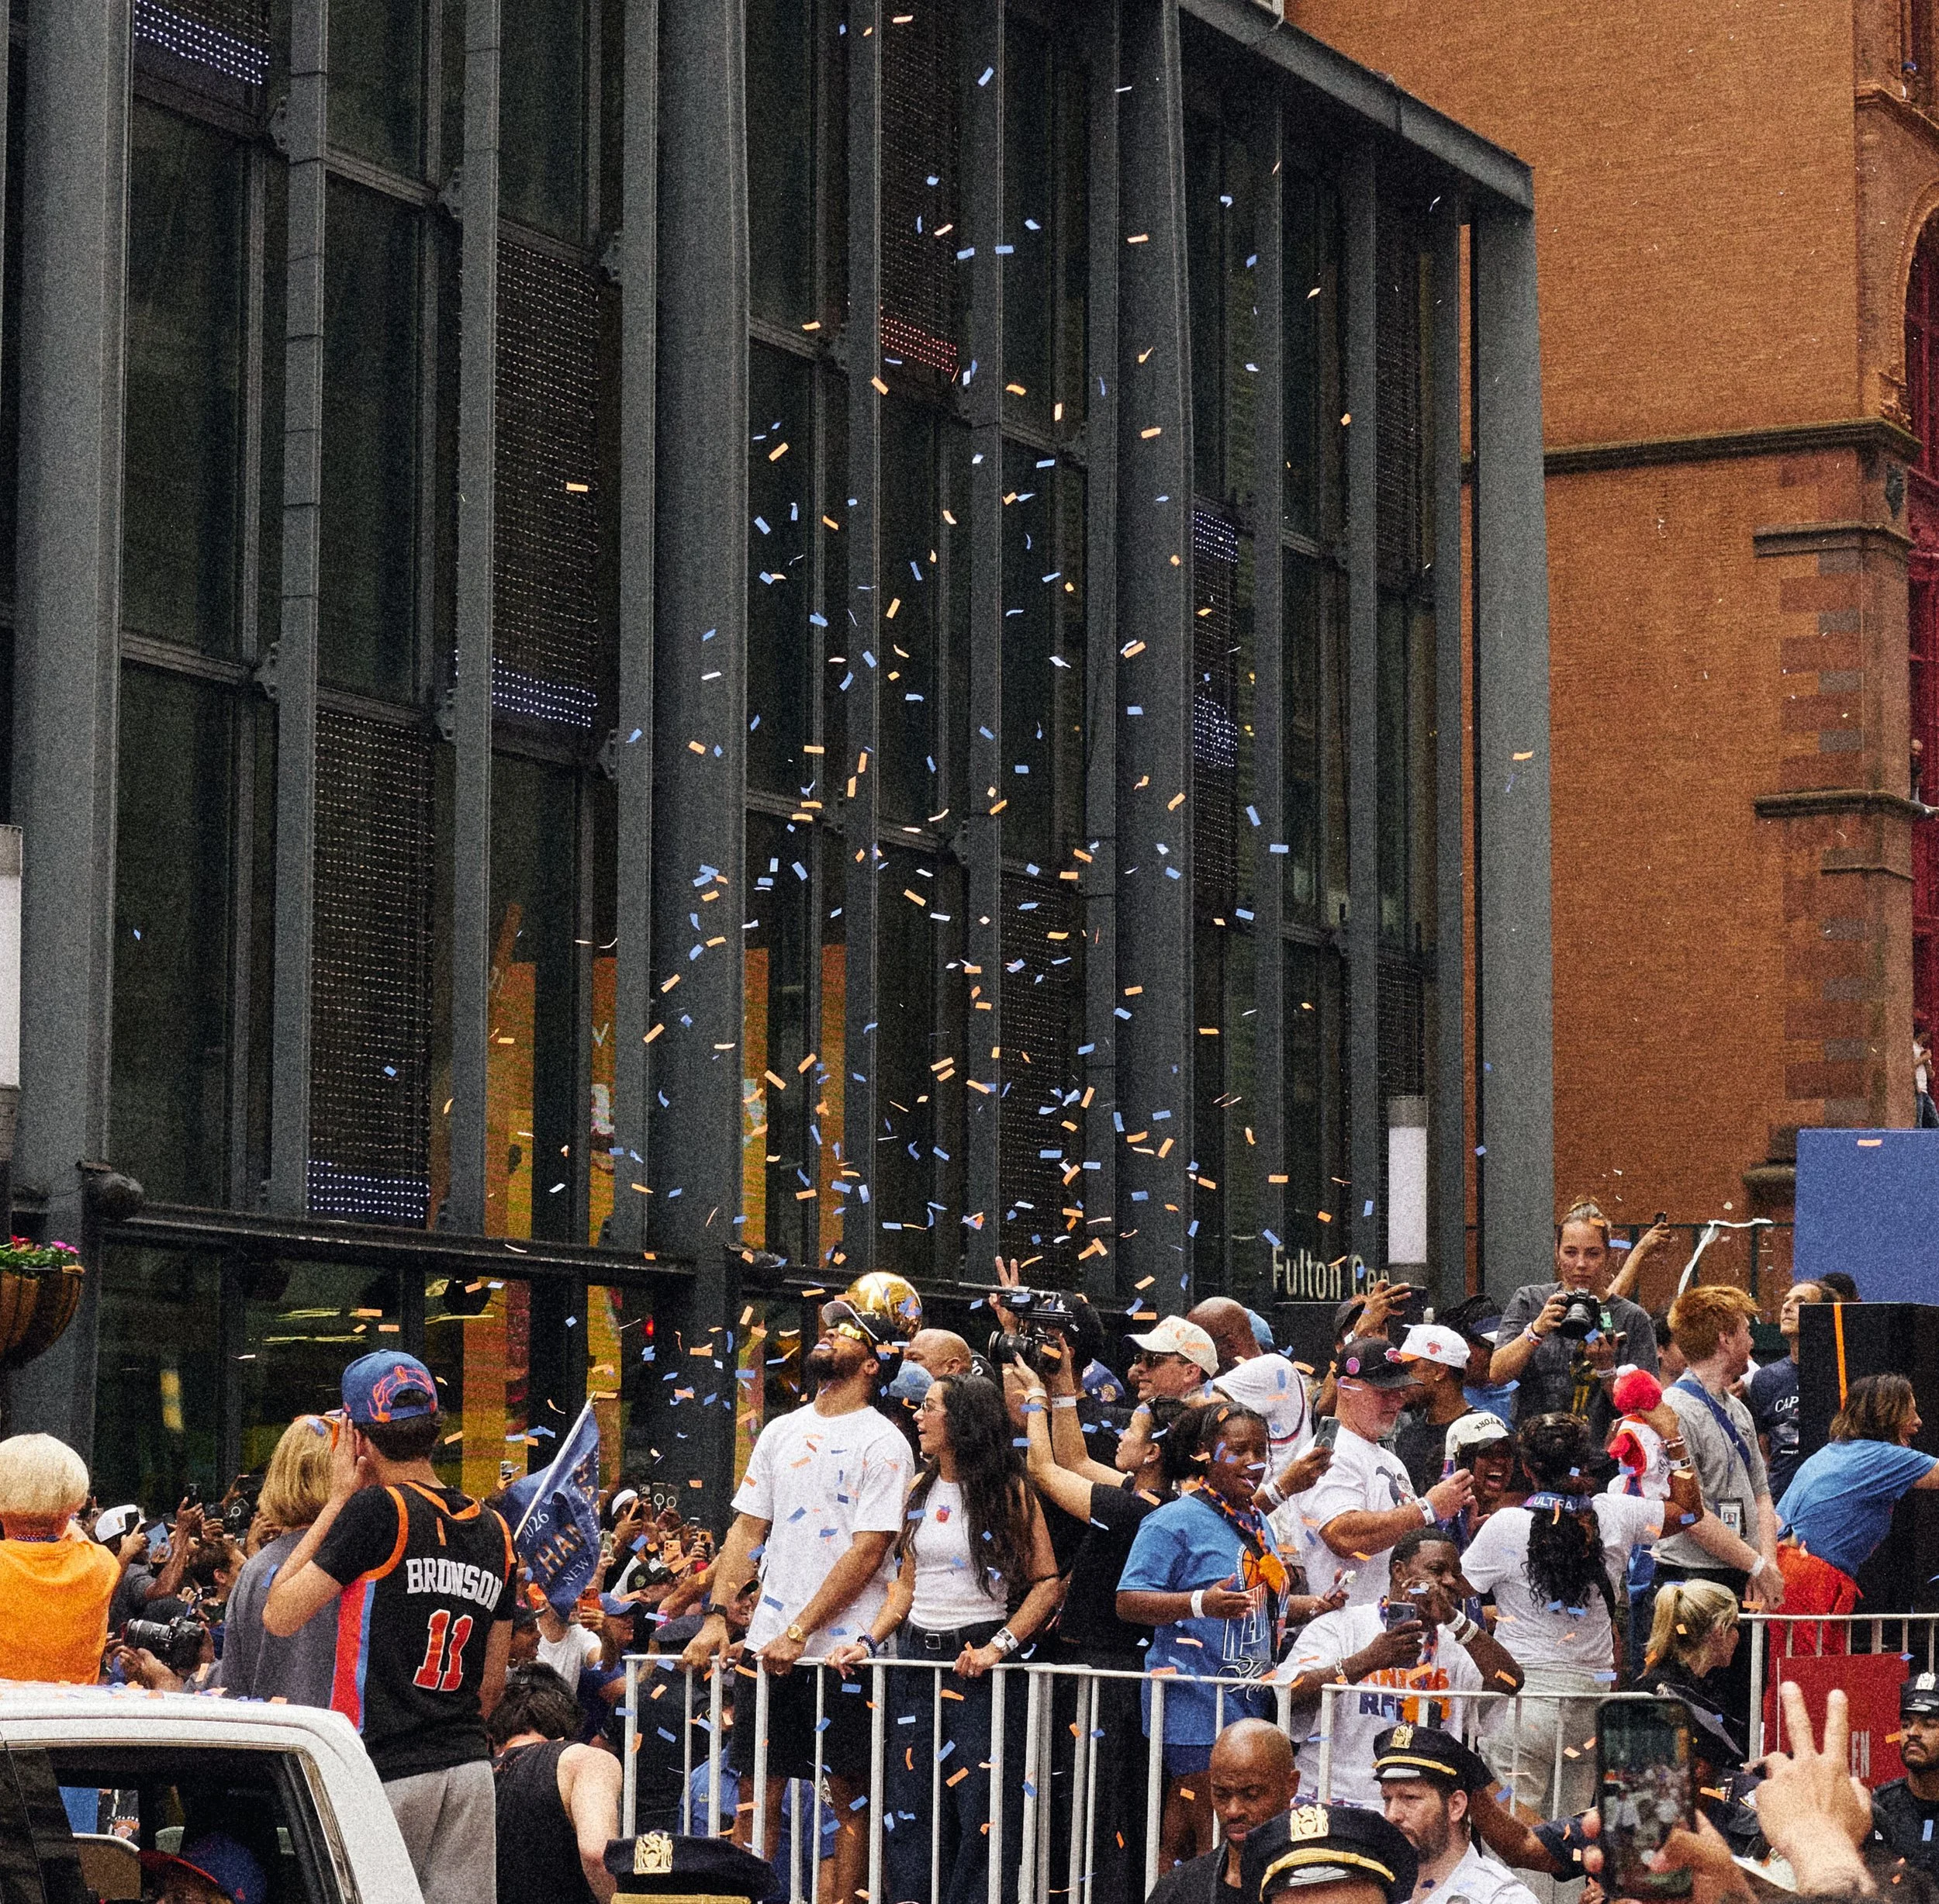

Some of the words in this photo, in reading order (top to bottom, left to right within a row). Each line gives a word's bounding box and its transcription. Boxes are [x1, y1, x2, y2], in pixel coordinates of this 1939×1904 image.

[1272, 1245, 1341, 1301] Fulton
[1474, 1417, 1495, 1432] YORK
[1533, 1497, 1573, 1511] ULTRA
[522, 1508, 549, 1545] 2026
[406, 1557, 503, 1612] BRONSON
[562, 1556, 590, 1585] NEW
[413, 1609, 473, 1691] 11
